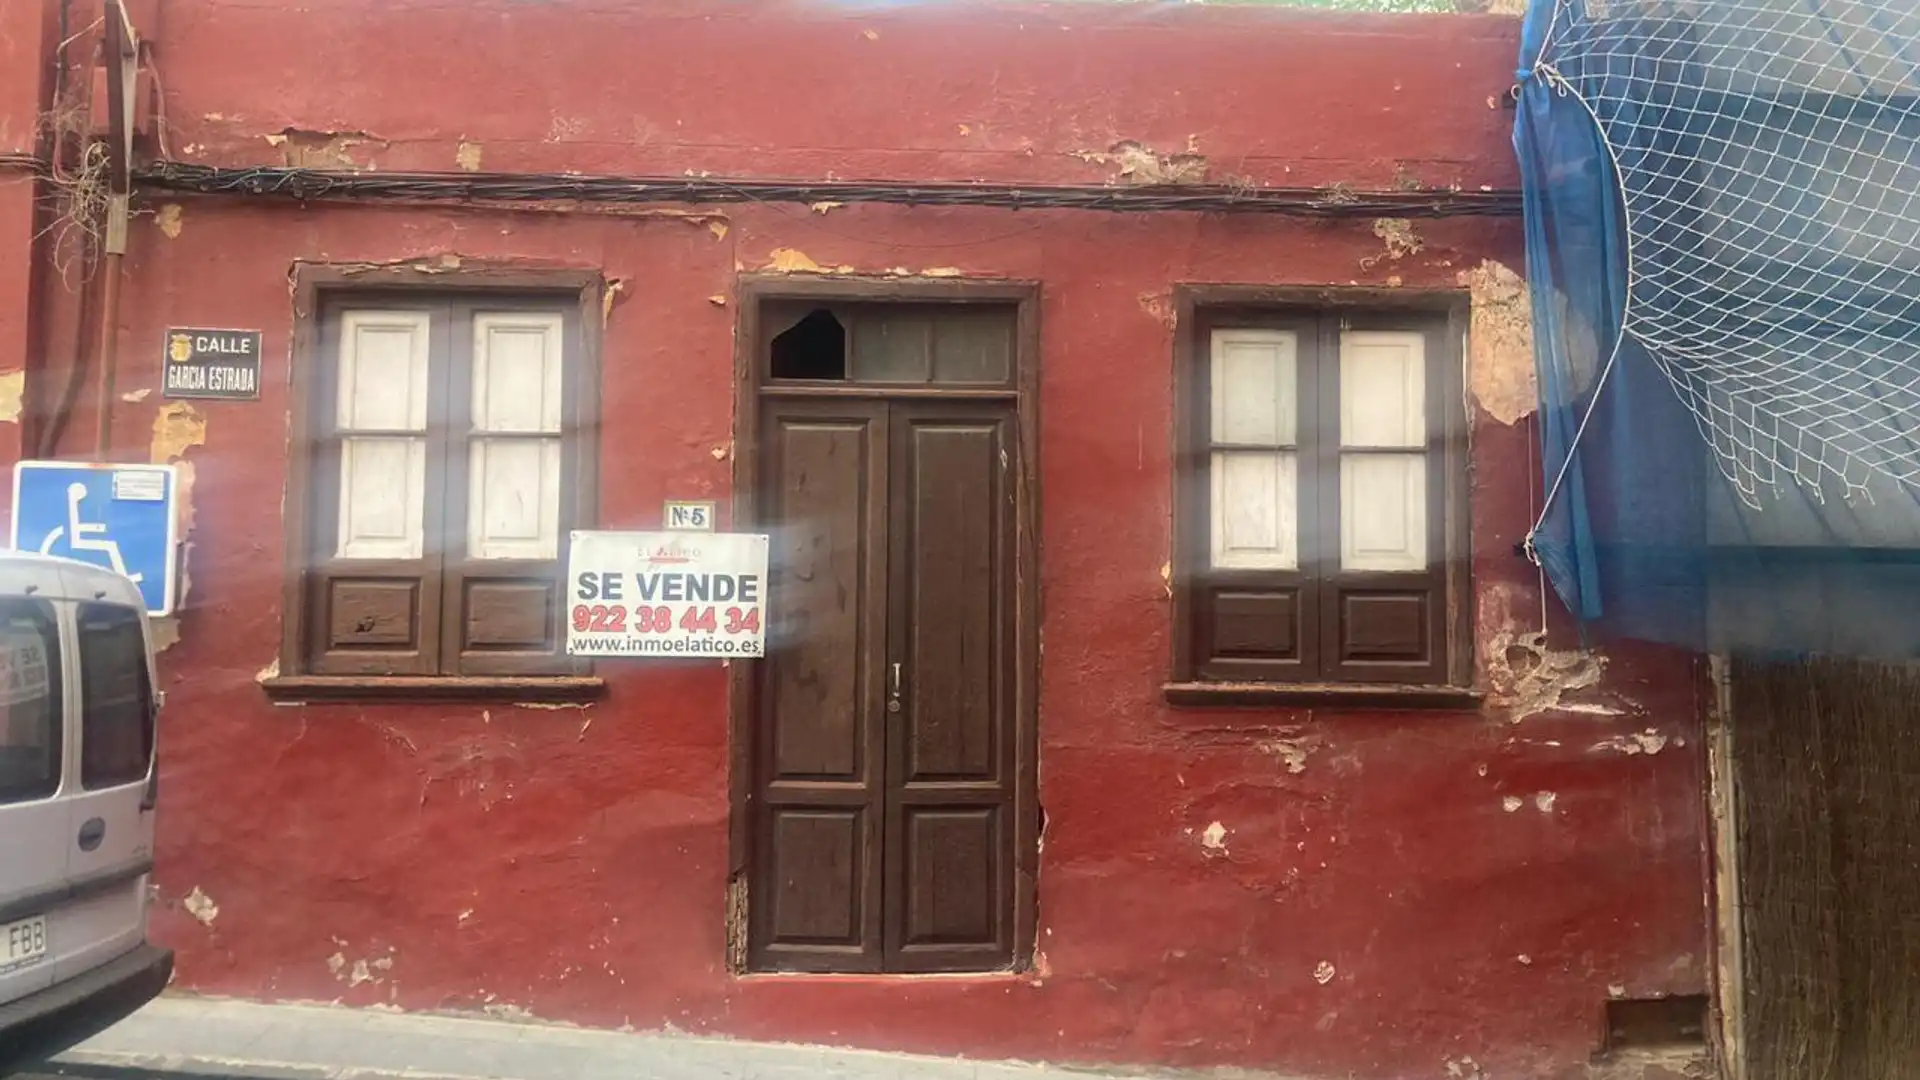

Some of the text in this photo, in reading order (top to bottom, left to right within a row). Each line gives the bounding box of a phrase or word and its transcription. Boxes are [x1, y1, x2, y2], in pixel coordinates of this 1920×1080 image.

[196, 336, 252, 354] CALLE
[168, 365, 255, 392] GARCIA ESTRADA
[577, 571, 758, 602] SE VENDE
[572, 604, 760, 635] 922 38 44 34
[573, 635, 759, 654] www.inmoelatico.es
[9, 921, 44, 957] FBB
